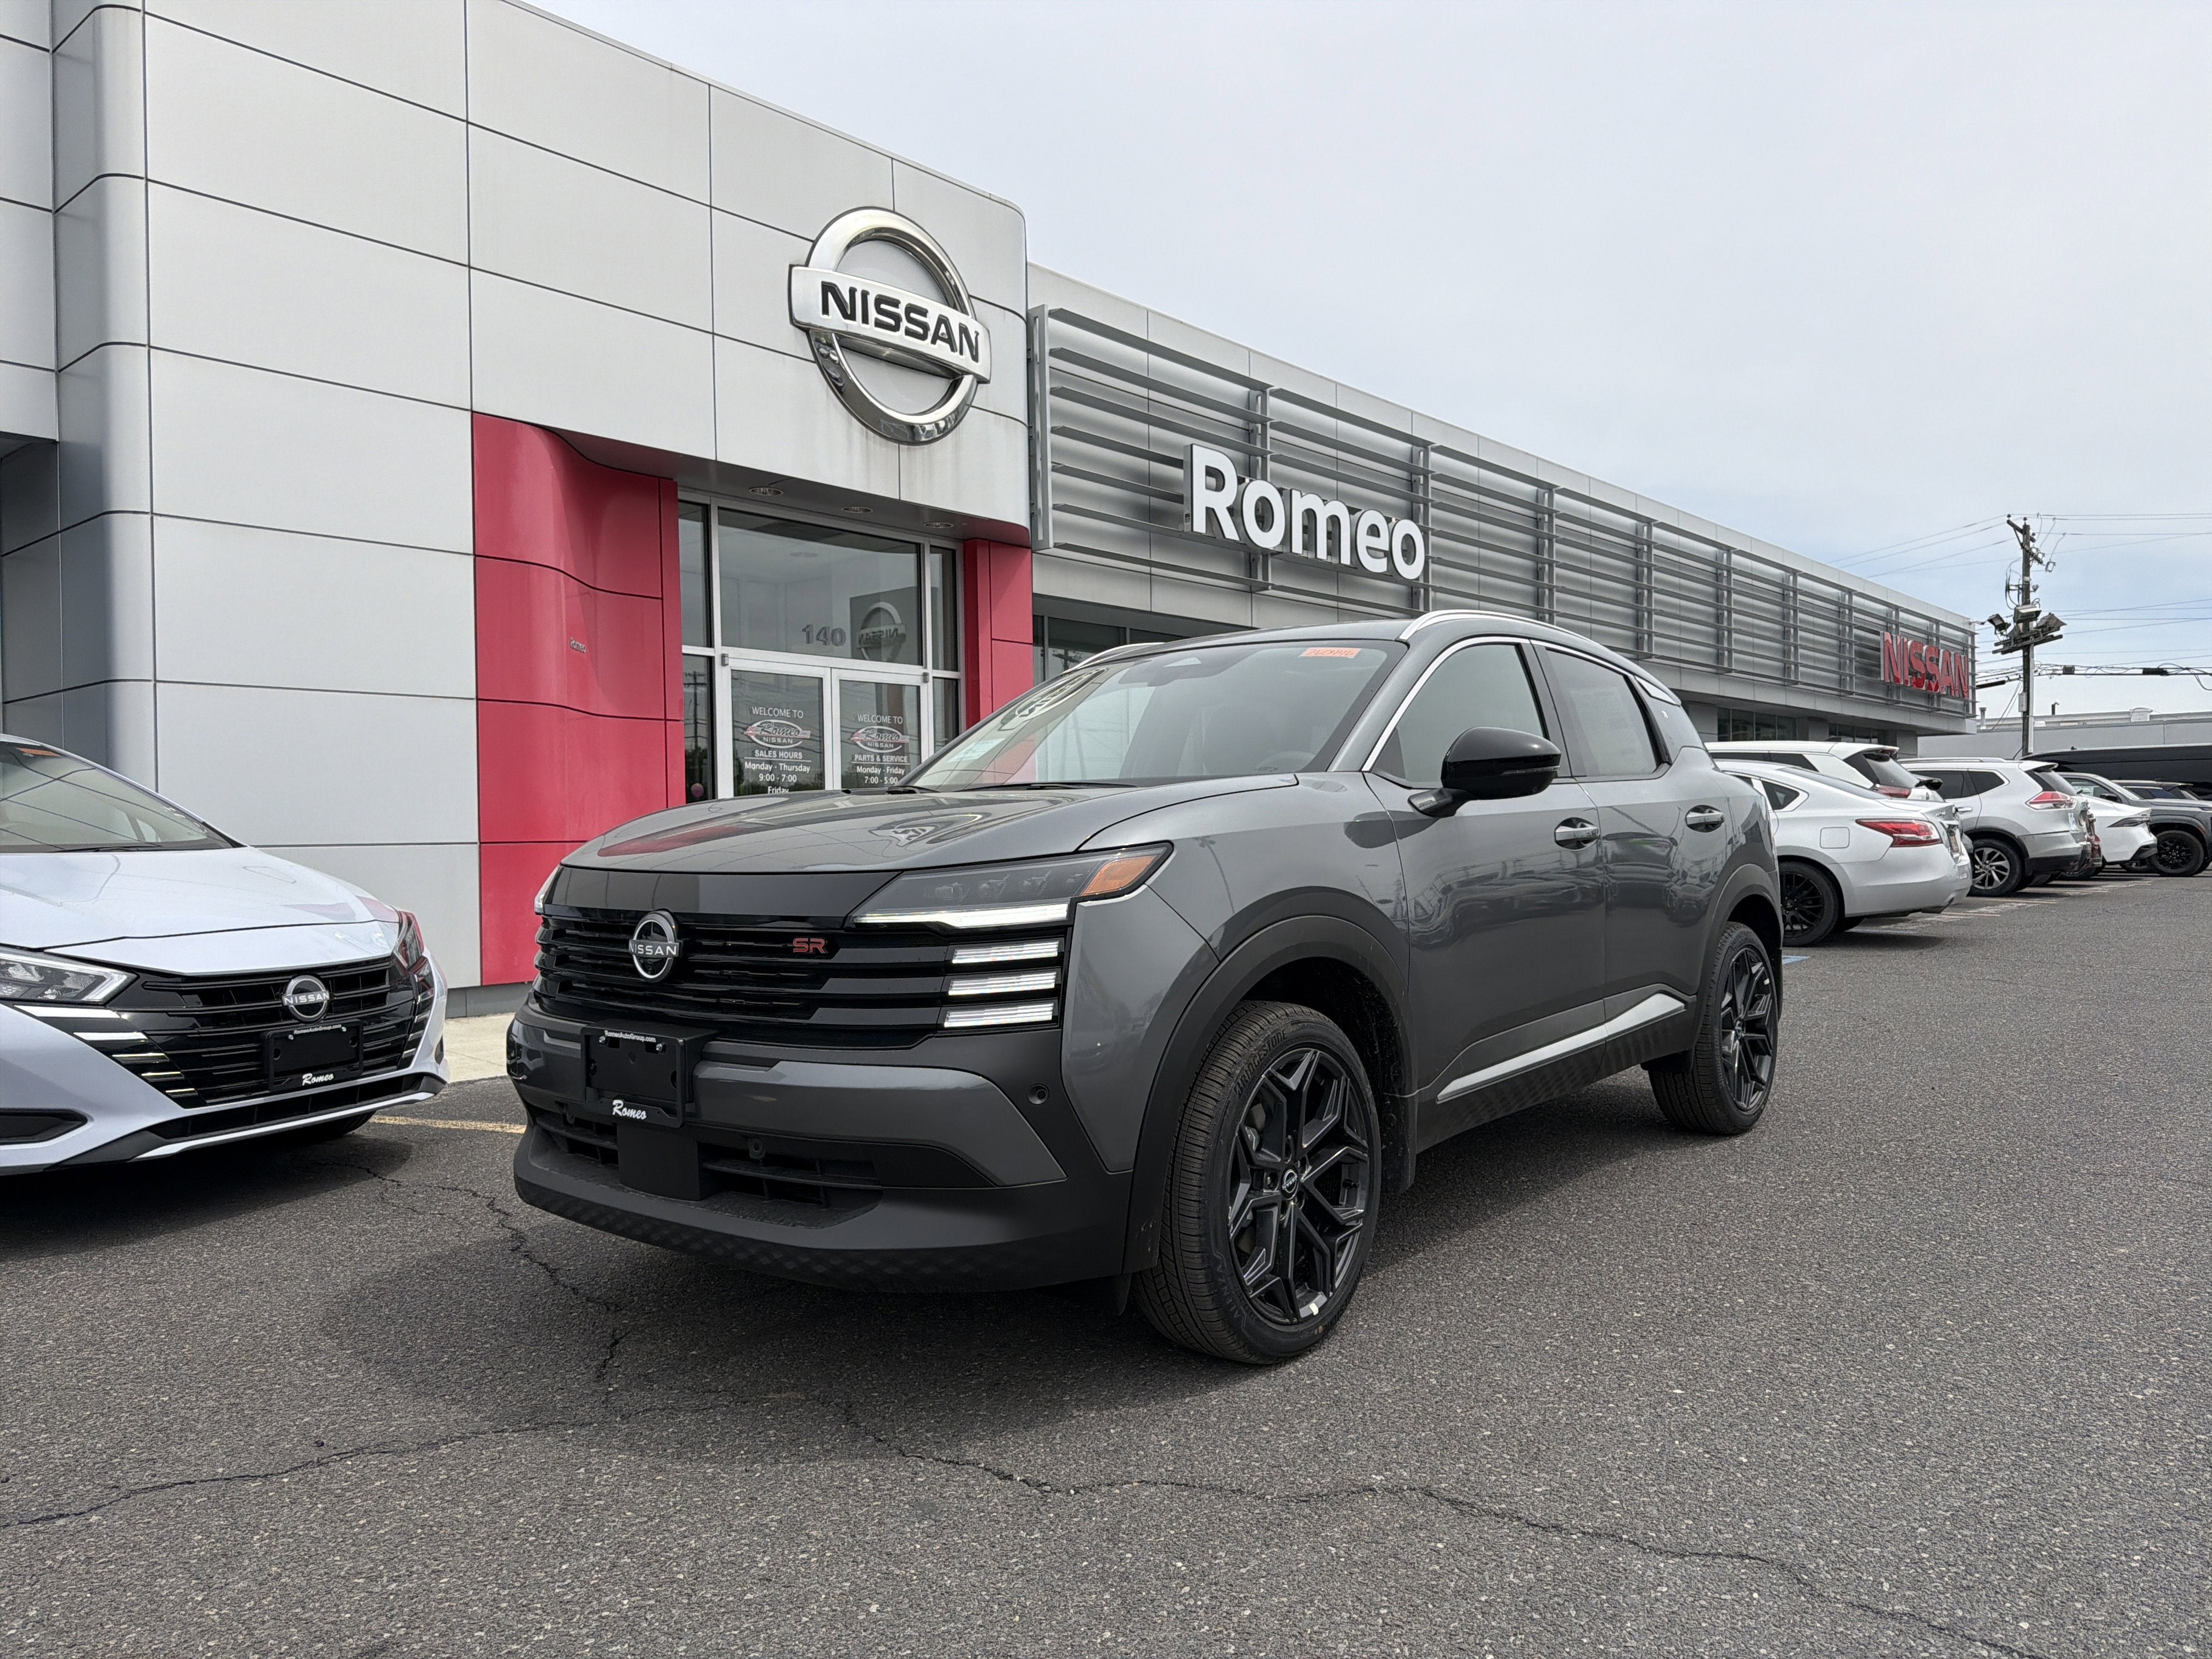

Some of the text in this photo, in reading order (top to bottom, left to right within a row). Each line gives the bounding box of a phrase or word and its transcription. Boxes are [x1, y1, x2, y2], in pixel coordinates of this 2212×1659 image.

[821, 280, 980, 363] NISSAN
[1188, 443, 1425, 580] Romeo
[802, 624, 846, 647] 140
[1882, 631, 1969, 699] NISSAN
[752, 706, 804, 719] WELCOME TO
[857, 714, 903, 724] WELCOME TO
[757, 721, 800, 736] Romeo
[863, 727, 900, 741] Romeo
[755, 749, 803, 759] SALES HOURS
[744, 761, 773, 772] Monday
[779, 763, 810, 774] Thursday
[857, 765, 881, 775] Monday
[887, 766, 905, 776] Friday
[759, 773, 775, 781] 9:00
[884, 776, 898, 785] 5:00
[768, 786, 789, 794] Friday
[629, 942, 676, 955] NISSAN
[793, 938, 825, 953] SR
[284, 992, 329, 1005] NISSAN
[294, 1024, 342, 1035] RomeoAutoGroup.com
[605, 1030, 657, 1043] RomeoAutoGroup.com
[1234, 1029, 1288, 1099] BRIDGESTONE
[302, 1073, 334, 1086] Romeo
[612, 1099, 647, 1120] Romeo
